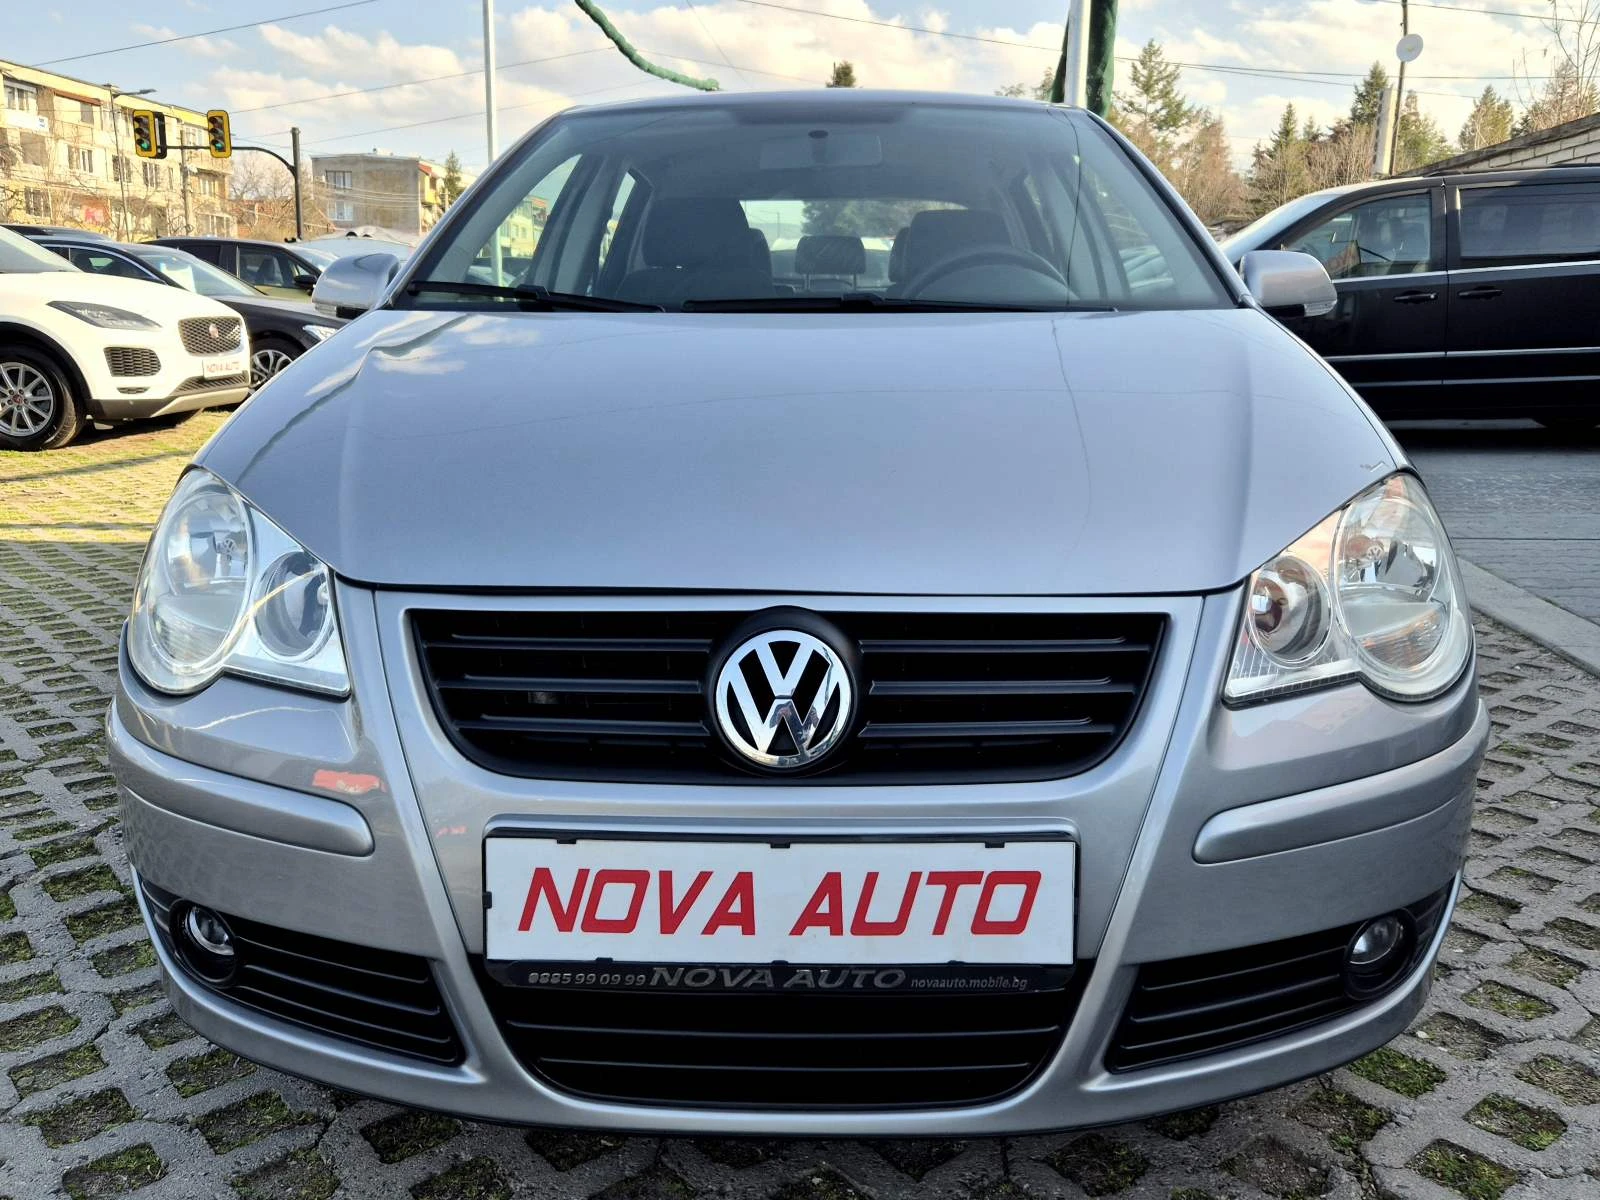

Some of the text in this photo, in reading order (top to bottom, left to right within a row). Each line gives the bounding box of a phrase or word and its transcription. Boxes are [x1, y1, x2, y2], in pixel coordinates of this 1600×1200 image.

[717, 630, 851, 768] VW
[519, 867, 1042, 937] NOVA AUTO
[574, 973, 596, 985] 99
[599, 973, 621, 985] 09
[624, 974, 646, 986] 99
[650, 967, 774, 988] NOVA
[783, 969, 907, 989] AUTO
[911, 975, 1028, 991] novaauto.mobile.bg
